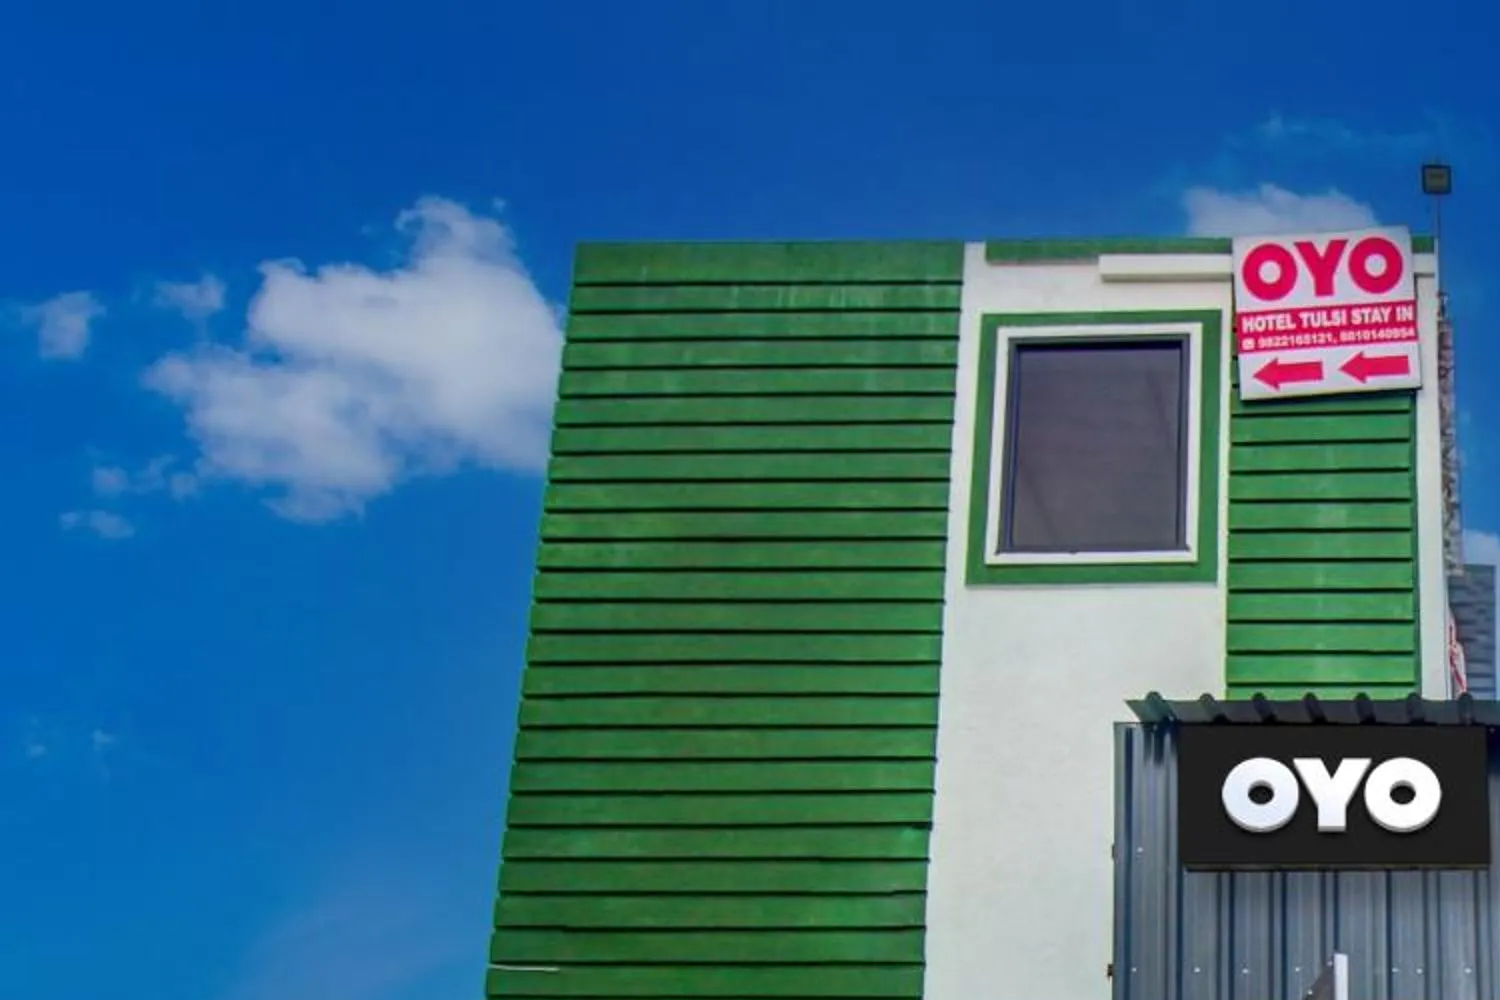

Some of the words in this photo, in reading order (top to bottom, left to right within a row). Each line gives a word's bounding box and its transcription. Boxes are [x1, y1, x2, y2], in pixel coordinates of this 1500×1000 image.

[1242, 237, 1404, 302] OYO
[1241, 314, 1297, 333] HOTEL
[1298, 310, 1347, 329] TULSI
[1351, 305, 1392, 325] STAY
[1396, 304, 1413, 321] IN
[1221, 756, 1442, 833] OYO
